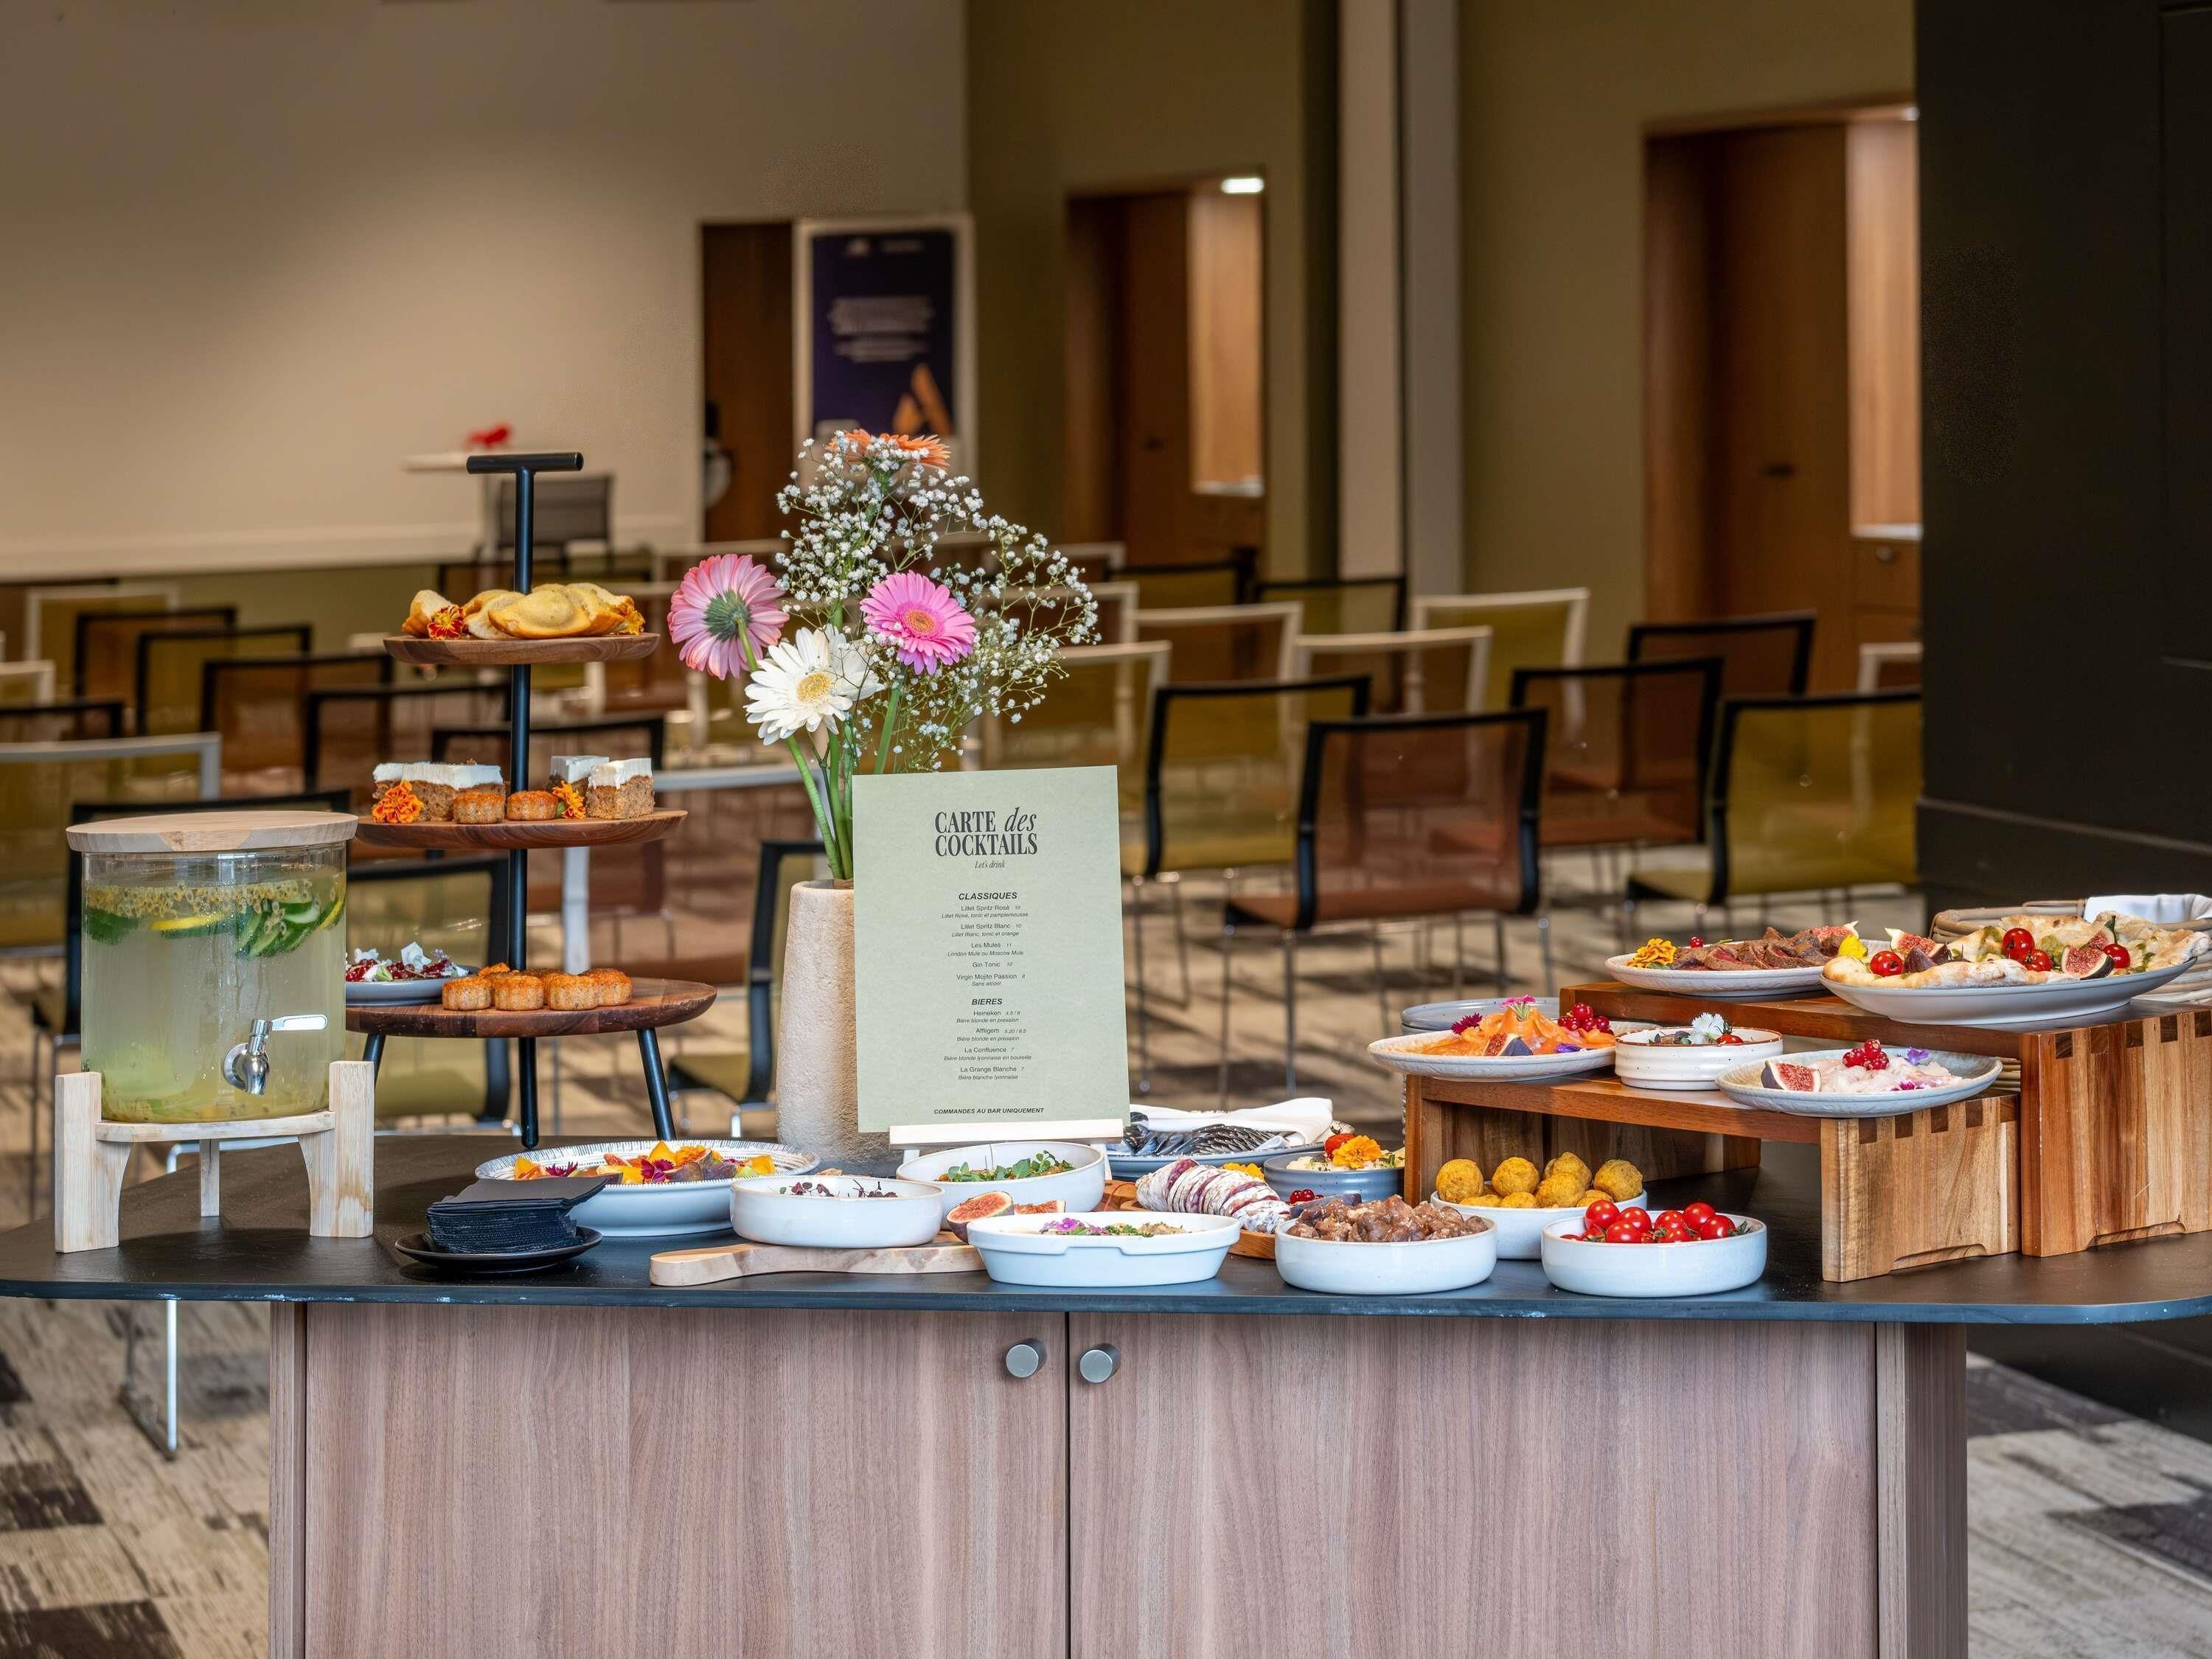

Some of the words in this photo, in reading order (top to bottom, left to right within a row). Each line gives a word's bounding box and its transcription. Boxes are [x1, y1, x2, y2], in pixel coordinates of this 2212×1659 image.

[935, 811, 995, 833] CARTE
[1004, 807, 1037, 831] des
[935, 832, 1037, 857] COCKTAILS
[959, 892, 1018, 900] CLASSIQUES
